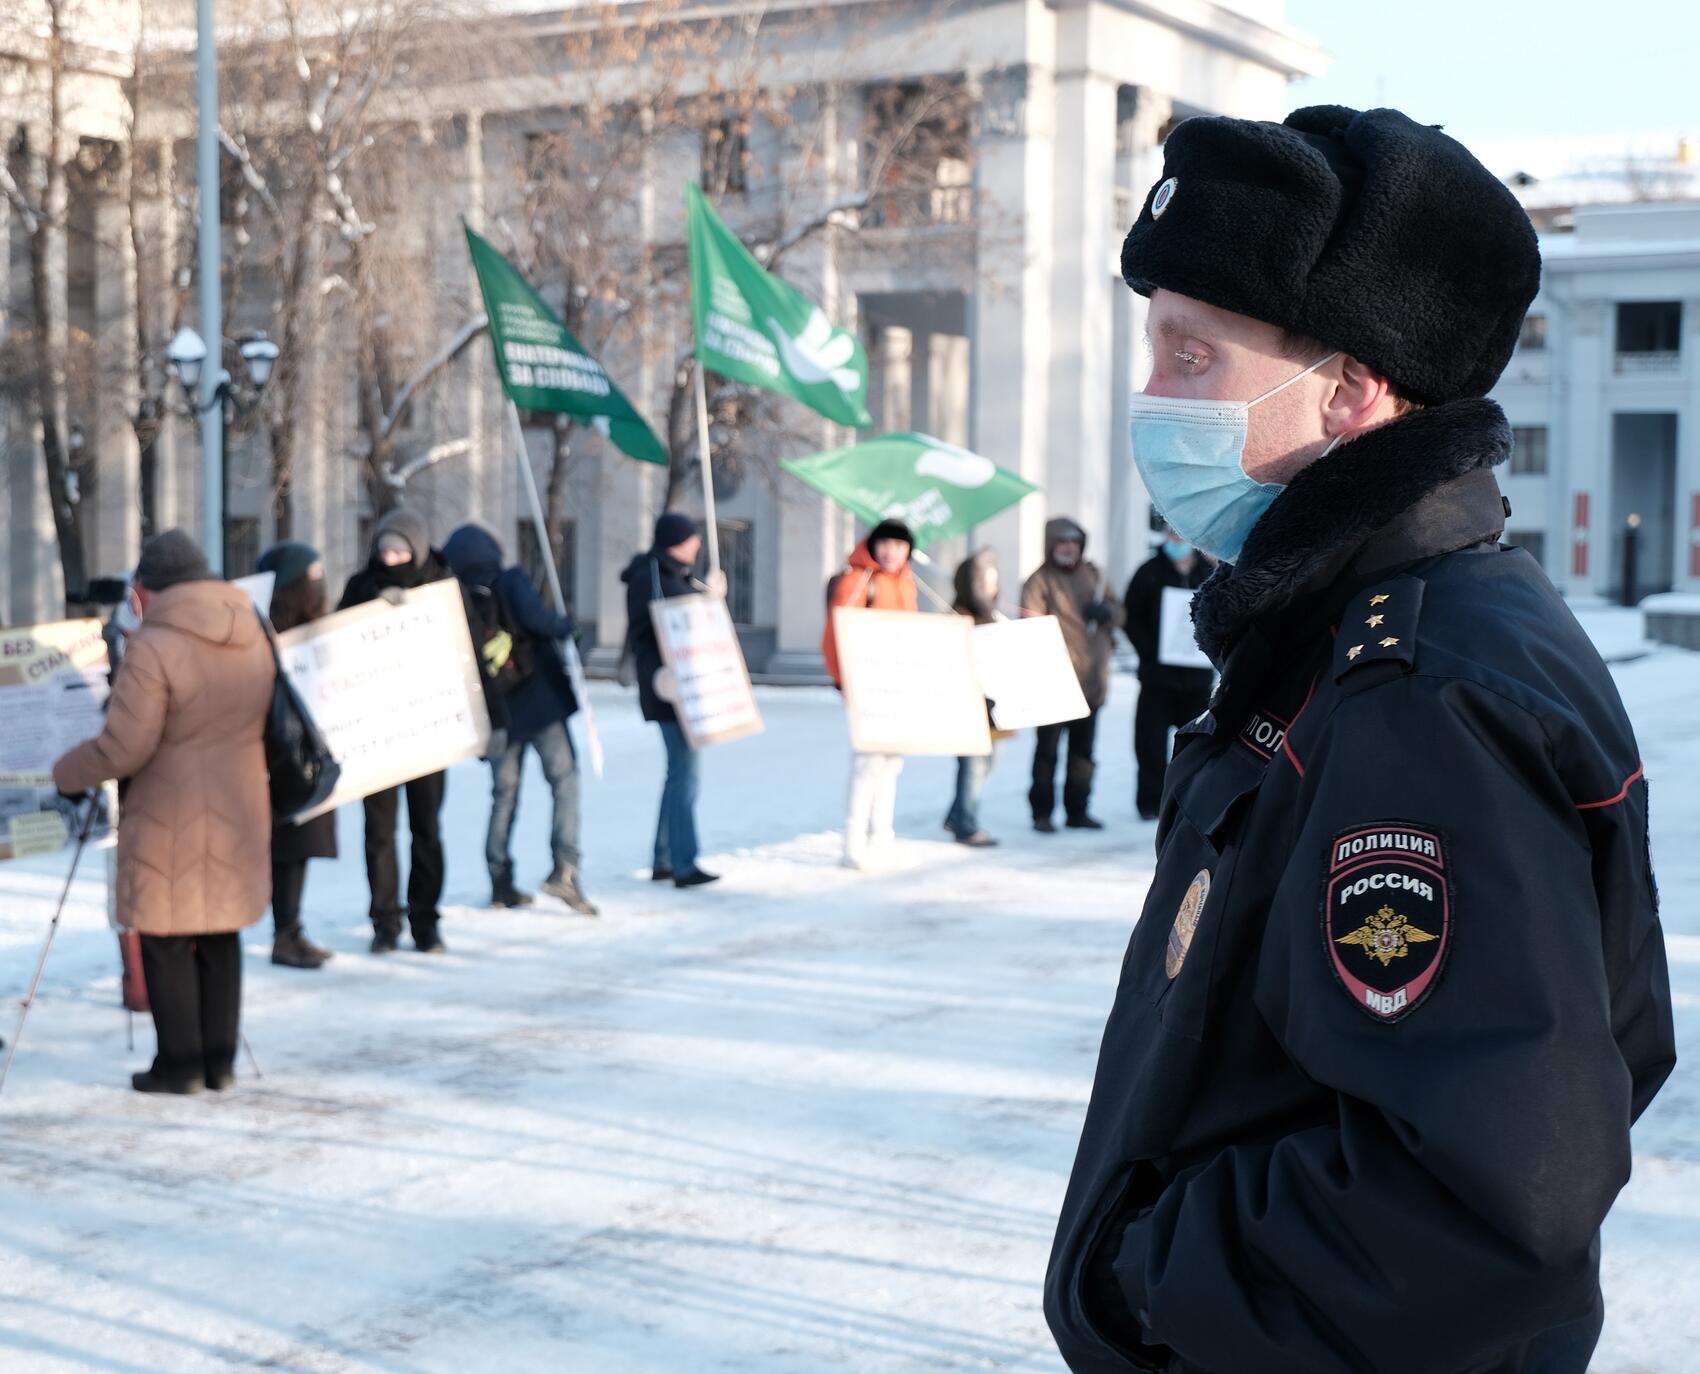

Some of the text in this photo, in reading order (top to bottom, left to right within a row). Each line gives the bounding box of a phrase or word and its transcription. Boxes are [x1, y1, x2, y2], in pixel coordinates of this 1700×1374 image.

[1338, 834, 1436, 861] ПОЛИЦИЯ
[1341, 873, 1433, 904] РОССИЯ
[1366, 988, 1407, 1014] МВД
